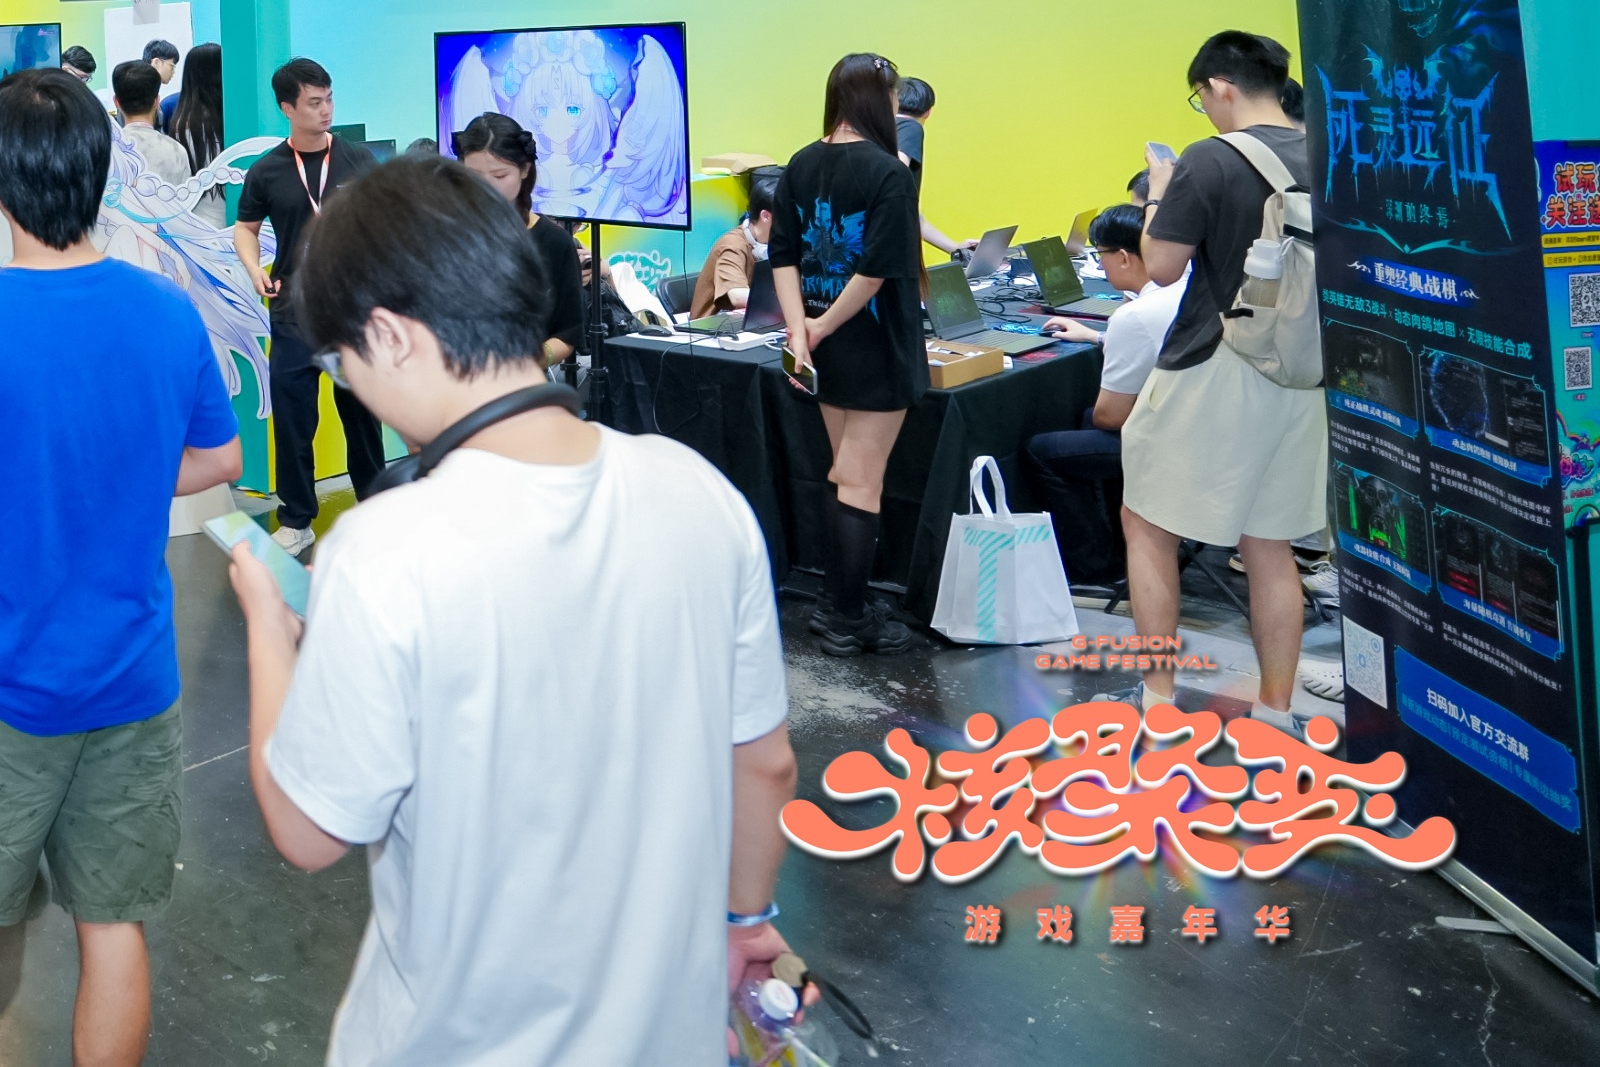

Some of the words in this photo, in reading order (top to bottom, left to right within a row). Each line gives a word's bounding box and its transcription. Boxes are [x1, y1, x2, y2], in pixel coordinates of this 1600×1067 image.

[1553, 162, 1600, 194] 试玩
[1374, 261, 1458, 302] 重塑经典战棋
[1394, 307, 1456, 338] 动态肉鸽地图
[1467, 327, 1533, 360] 无限技能合成
[1427, 687, 1529, 763] 扫码加入官方交流群
